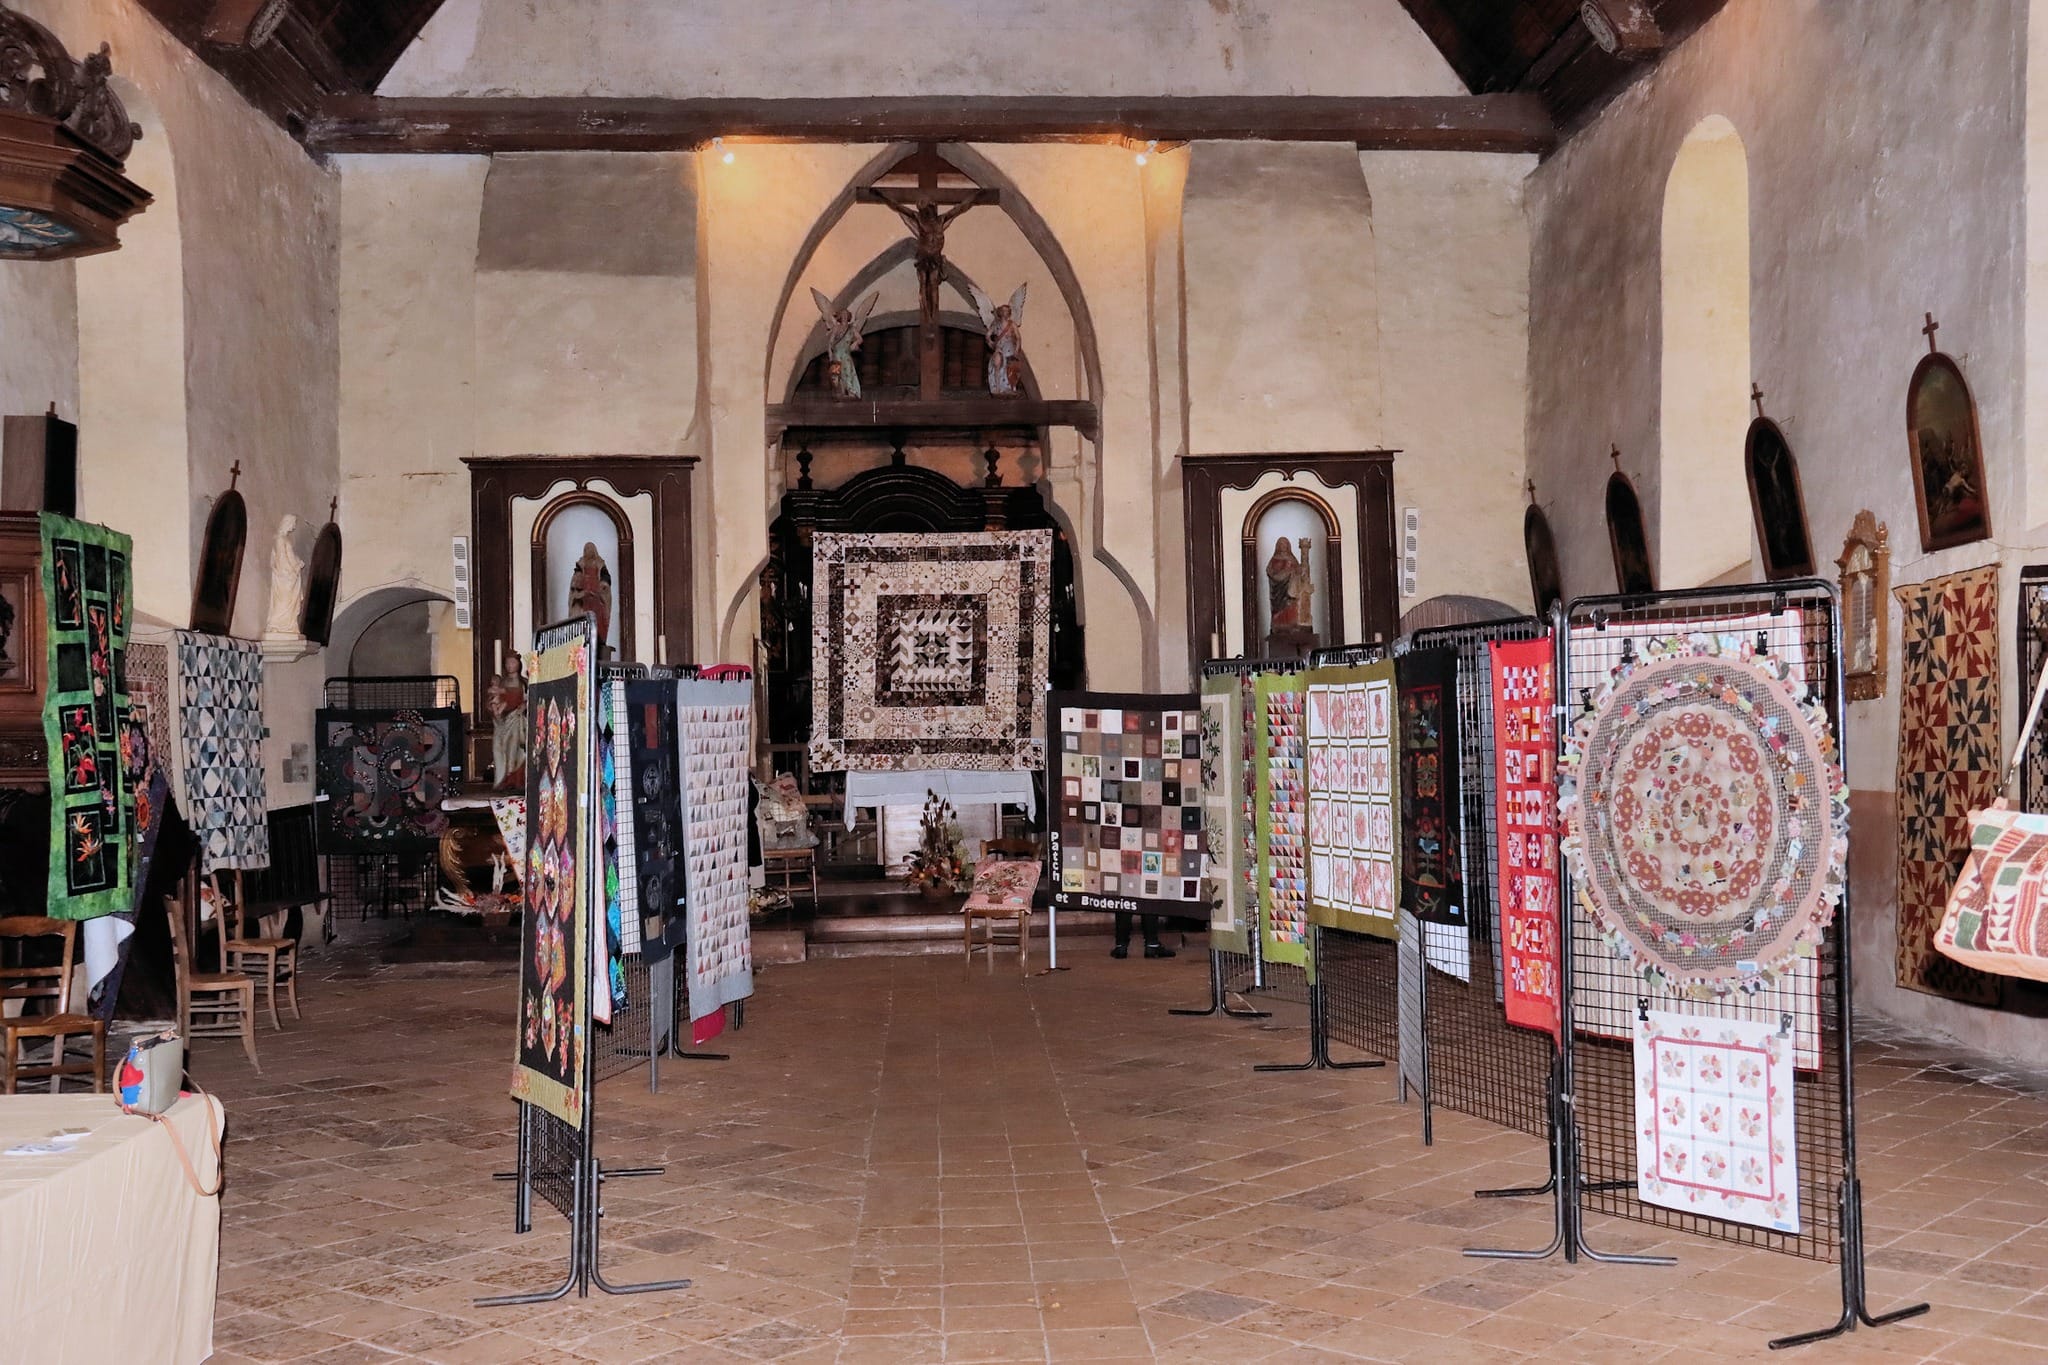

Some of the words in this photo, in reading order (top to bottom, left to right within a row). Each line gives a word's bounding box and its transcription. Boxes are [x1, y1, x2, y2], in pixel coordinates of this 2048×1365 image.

[1050, 831, 1060, 882] Patch
[1055, 893, 1068, 903] et
[1081, 896, 1137, 910] Broderies
